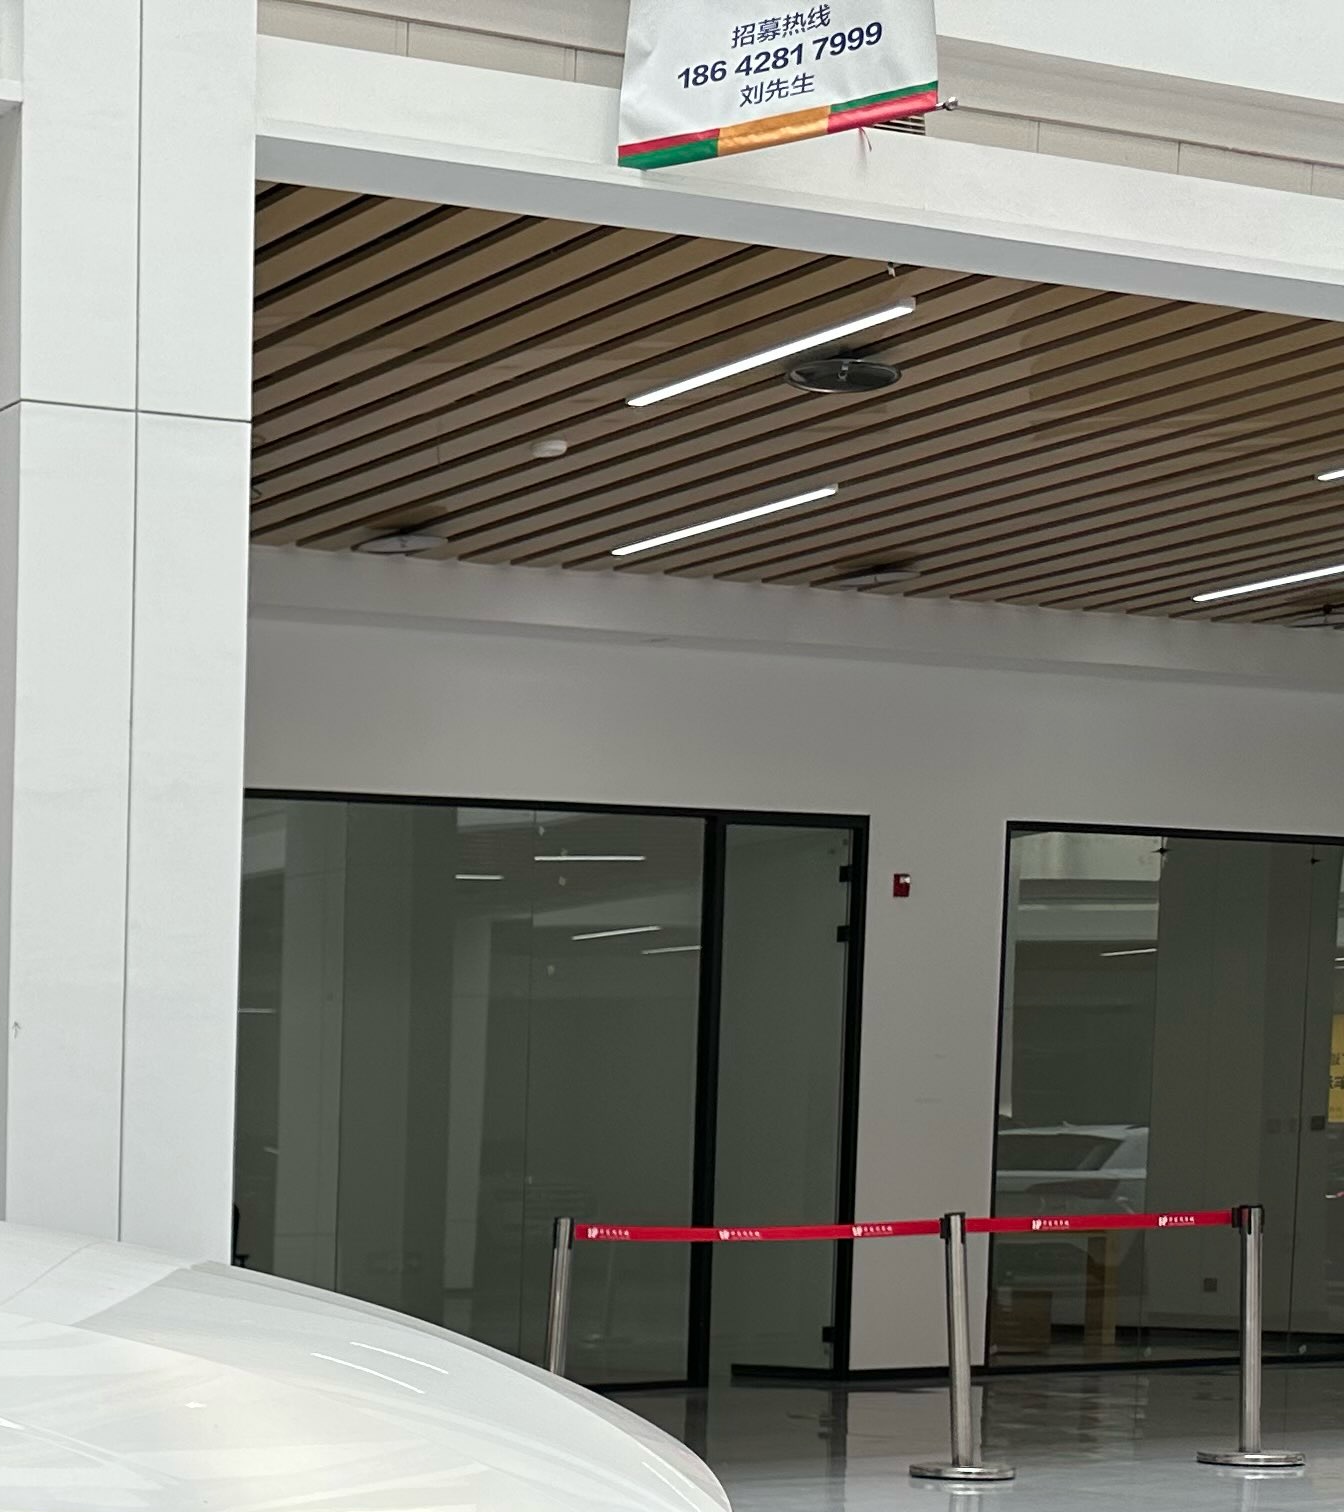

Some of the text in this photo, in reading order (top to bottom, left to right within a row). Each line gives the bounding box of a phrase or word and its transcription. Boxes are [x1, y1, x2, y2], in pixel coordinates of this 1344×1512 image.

[730, 3, 831, 49] 招募热线
[677, 21, 883, 89] 186 4281 7999
[740, 72, 815, 107] 刘先生
